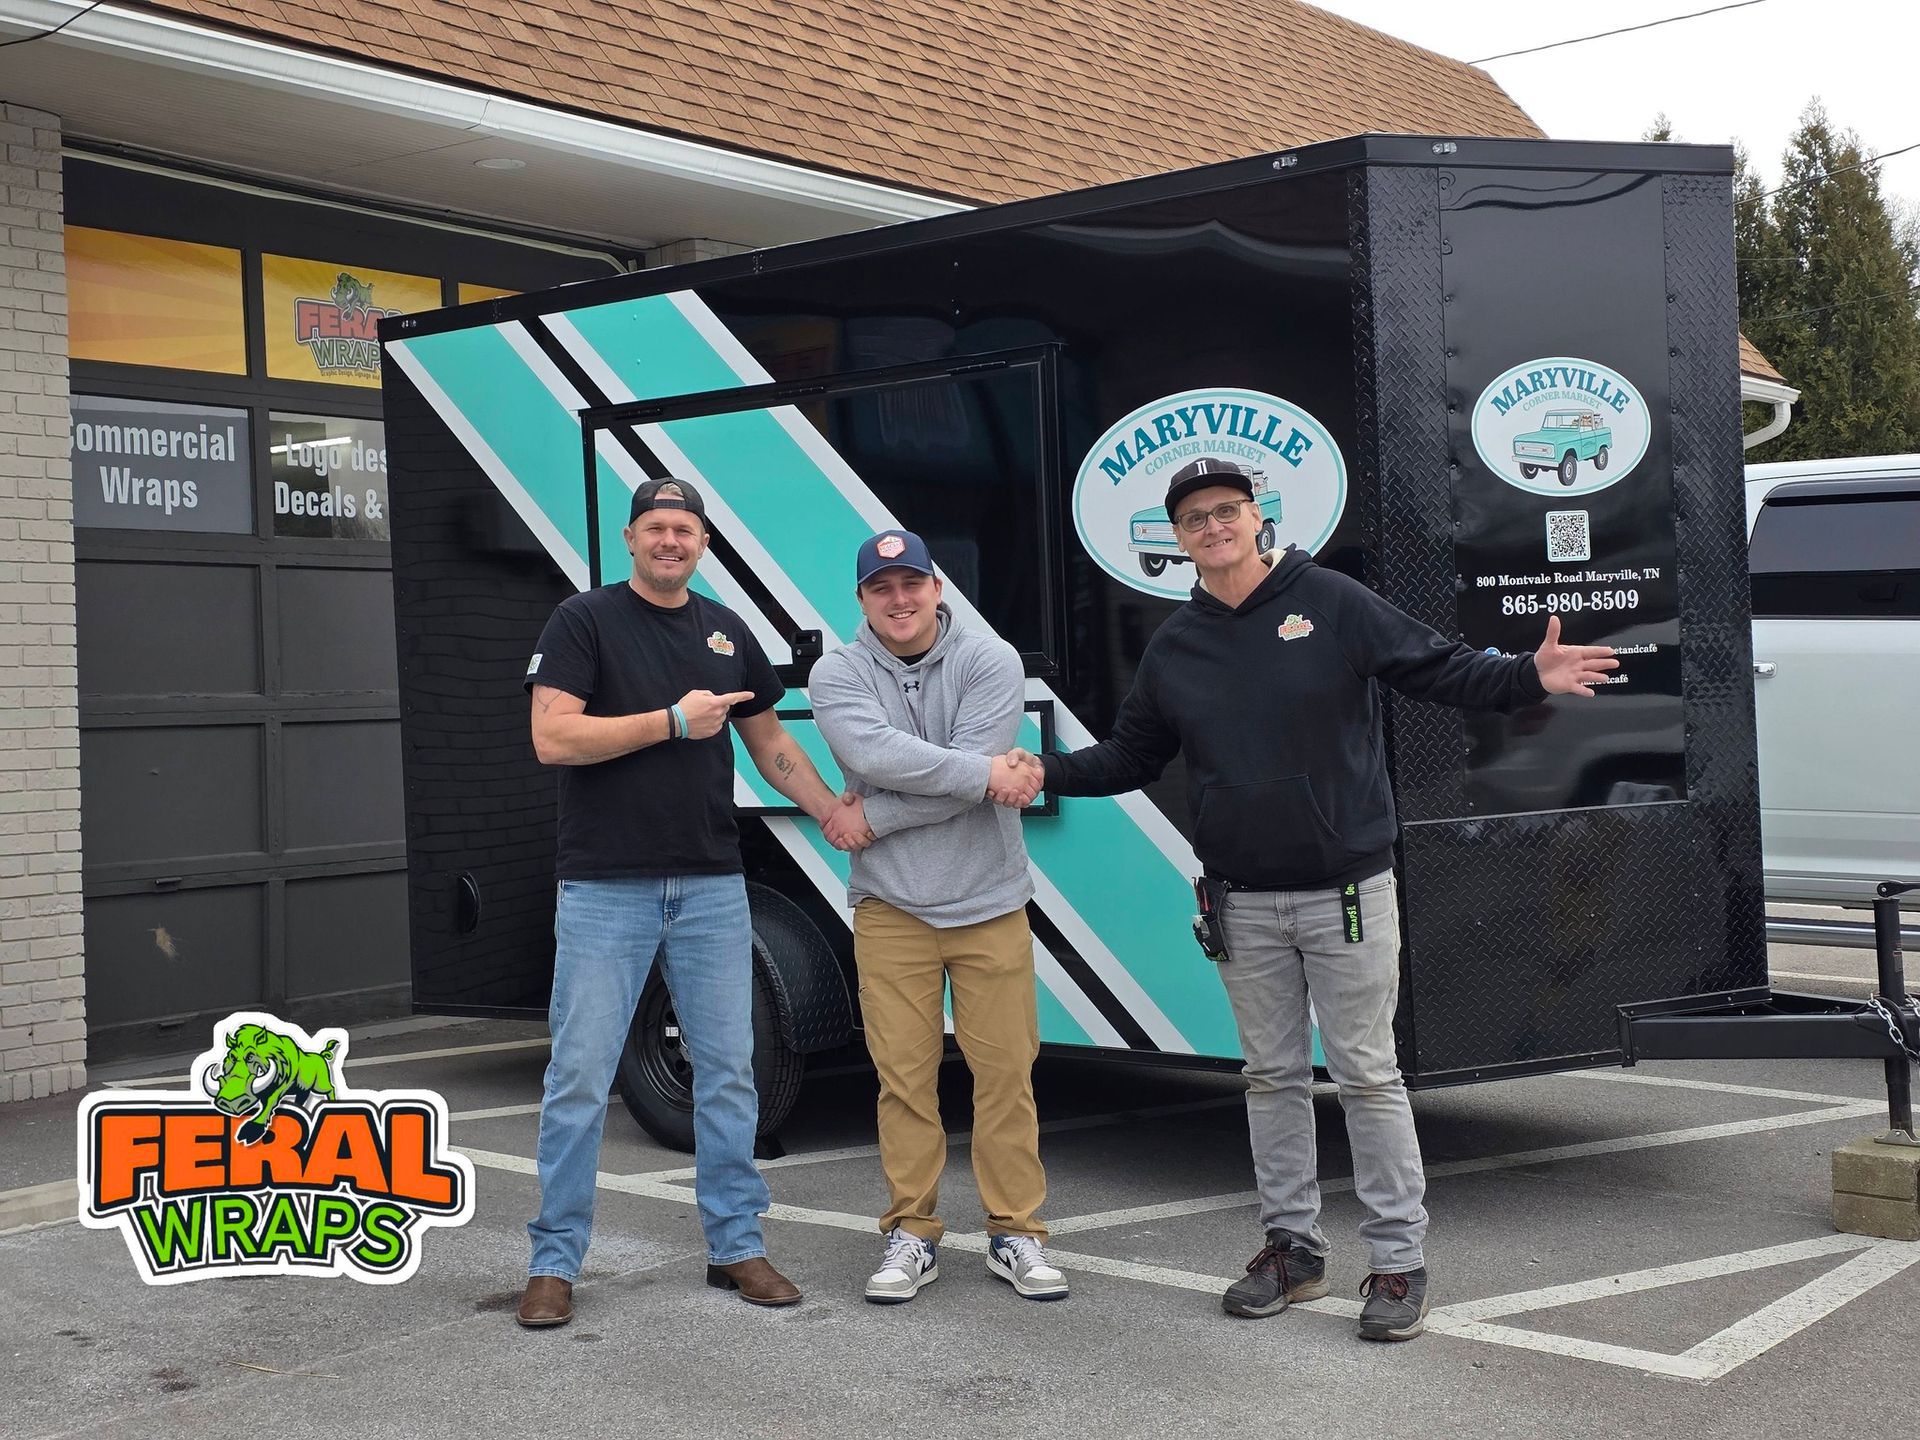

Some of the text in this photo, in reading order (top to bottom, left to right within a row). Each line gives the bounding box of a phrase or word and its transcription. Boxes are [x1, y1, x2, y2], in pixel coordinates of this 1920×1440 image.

[299, 302, 385, 340] FERA
[312, 339, 381, 368] WRAP
[1490, 367, 1631, 416] MARYVILLE
[1522, 390, 1602, 412] CORNER MARKET
[70, 423, 235, 462] ommercial
[286, 433, 343, 476] Logo
[1099, 403, 1313, 486] MARYVILLE
[1144, 439, 1266, 476] CORNER MARKET
[99, 466, 198, 515] Wraps
[274, 481, 383, 519] Decals &
[1476, 567, 1660, 587] 800 Montvale Road Maryville, TN
[1502, 589, 1639, 616] 865-980-8509
